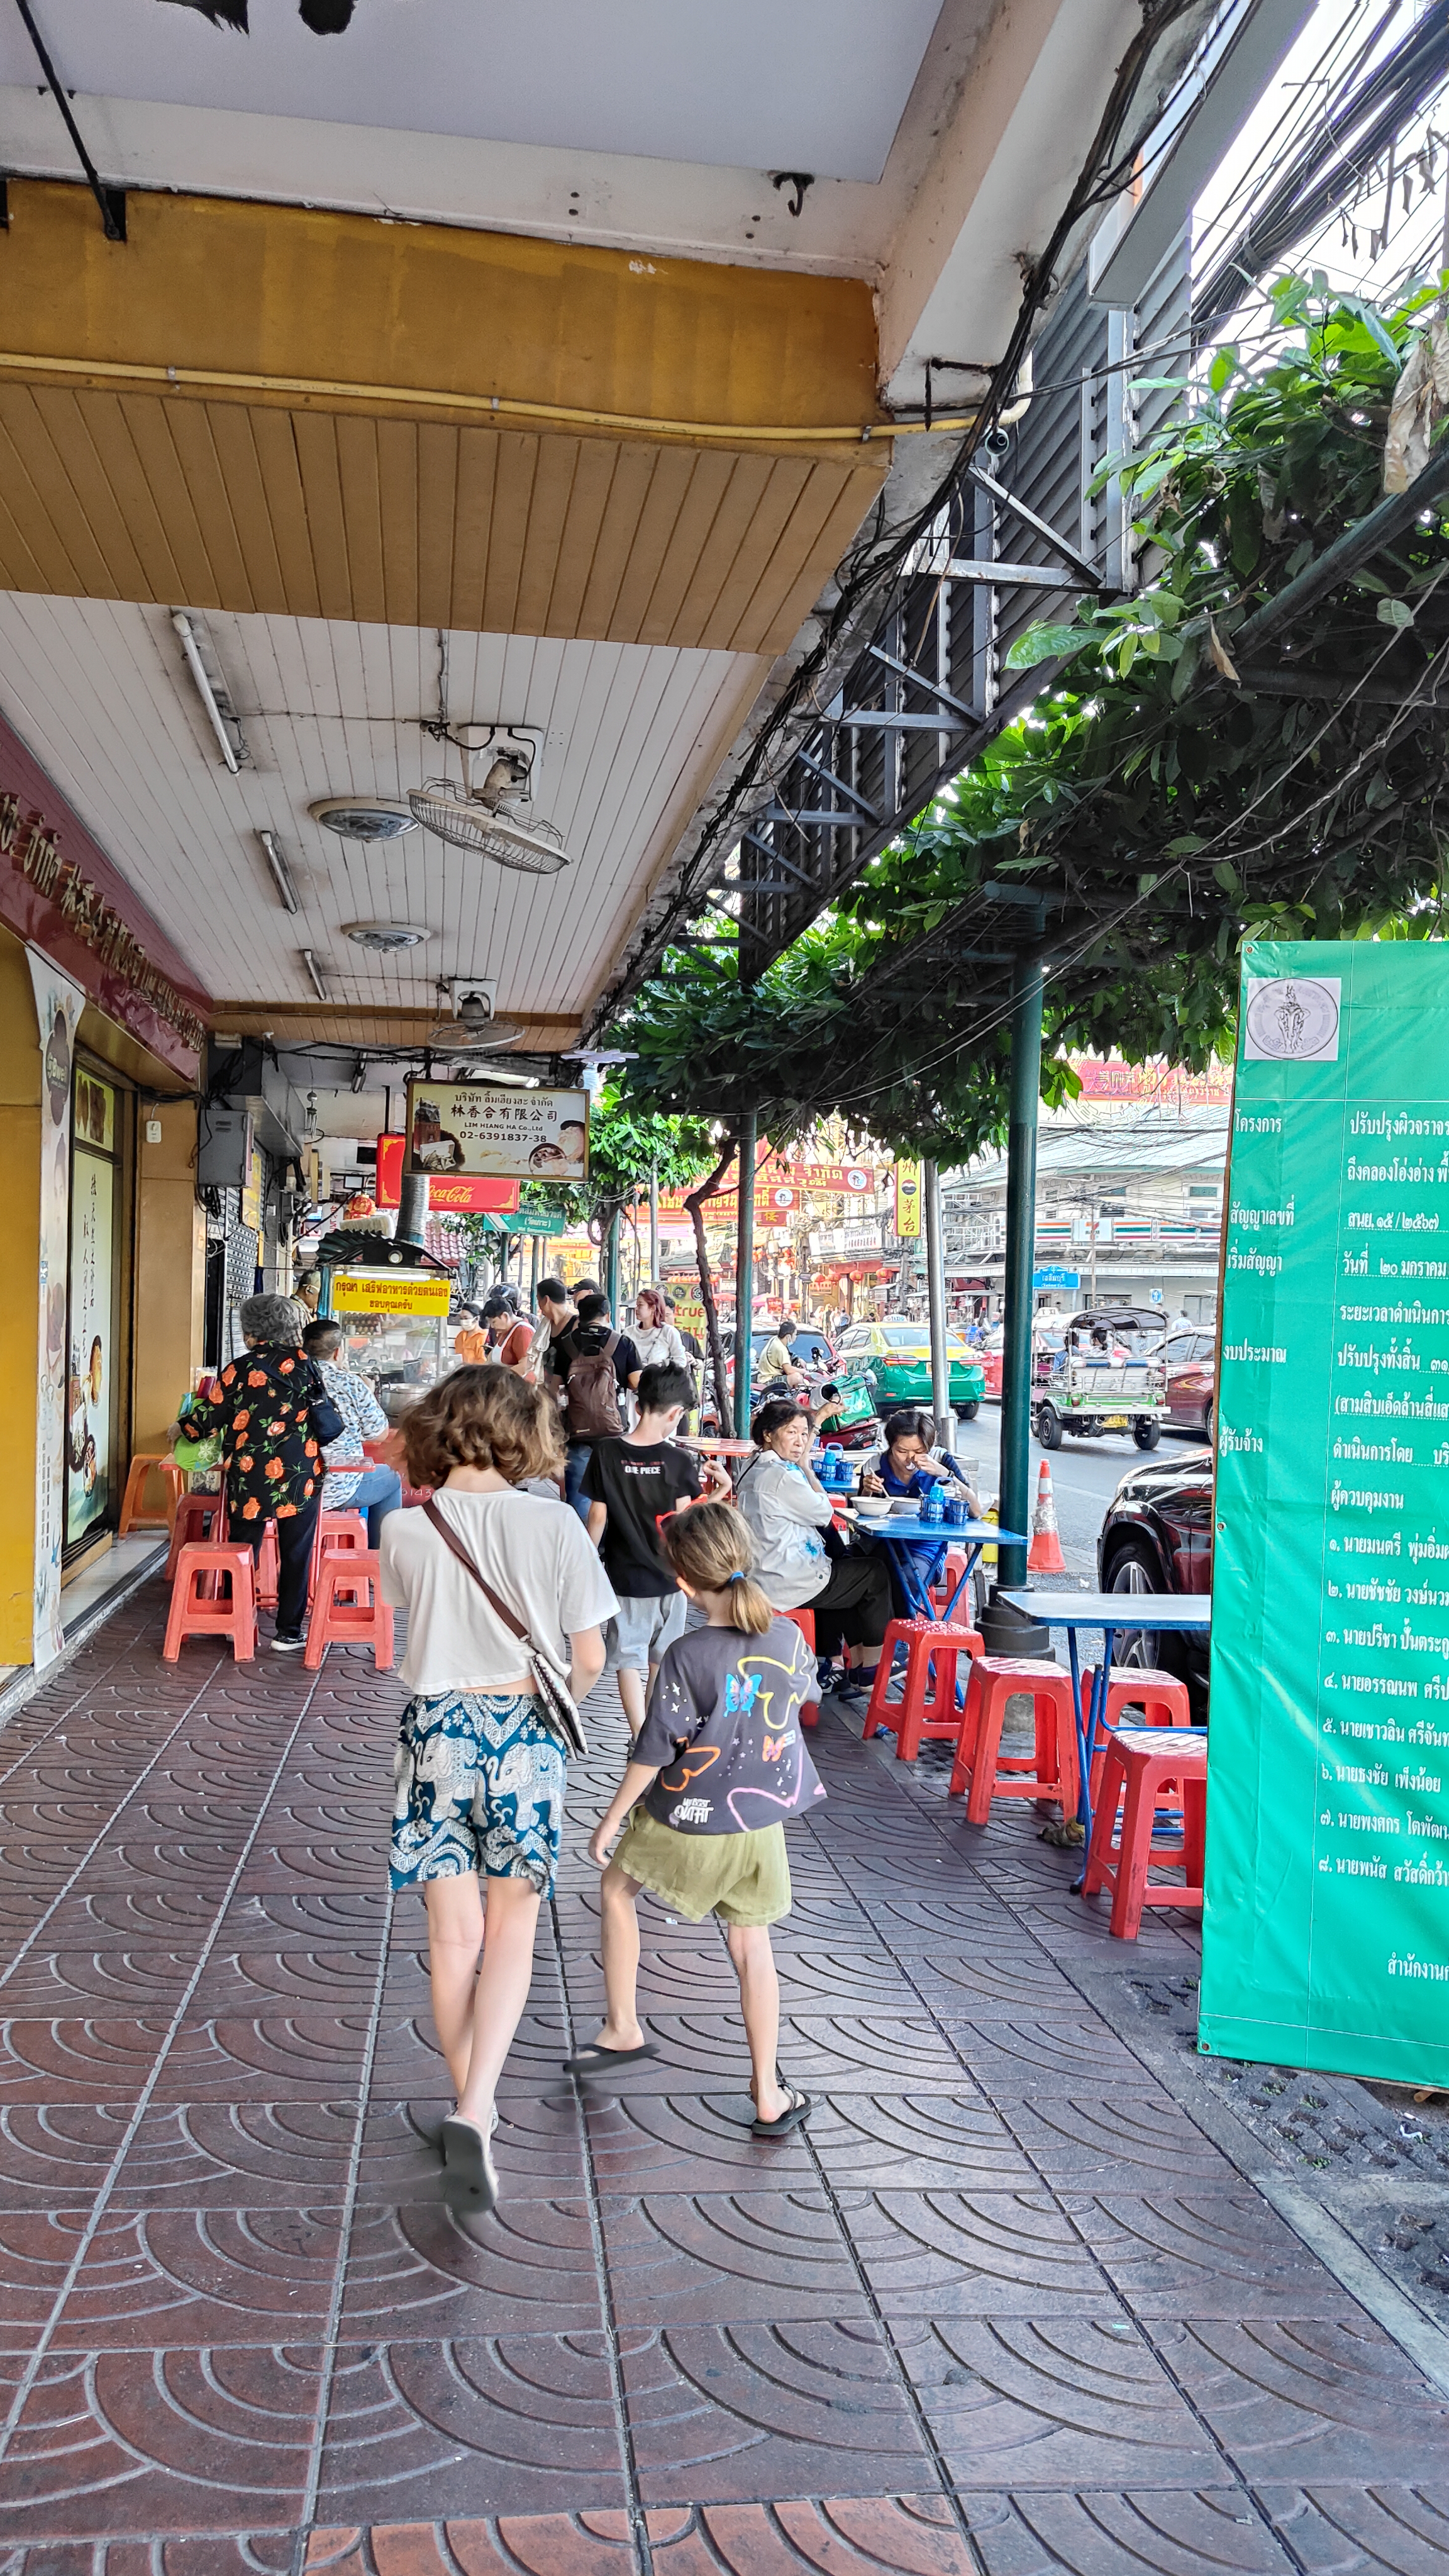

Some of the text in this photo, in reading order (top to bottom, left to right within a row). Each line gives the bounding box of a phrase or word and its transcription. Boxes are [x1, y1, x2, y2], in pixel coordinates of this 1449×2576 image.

[450, 1104, 557, 1122] 林香合有限公司
[531, 1096, 553, 1107] จำกัด
[1234, 1108, 1282, 1134] โครงการ
[460, 1131, 547, 1143] 02-6391837-38
[1348, 1150, 1449, 1183] ถึงคลองโอ่งอ่าง พื้
[1230, 1194, 1295, 1231] สัญญาเลขที่
[1227, 1243, 1283, 1277] เริ่มสัญญา
[1342, 1243, 1368, 1274] วันที่
[1401, 1260, 1447, 1276] มกราคม
[1223, 1338, 1287, 1363] งบประมาณ
[1338, 1337, 1420, 1376] ปรับปรุงทั้งสิ้น
[1219, 1426, 1263, 1458] ผู้รับจ้าง
[1333, 1436, 1413, 1464] ดำเนินการโดย
[1331, 1480, 1404, 1514] ผู้ควบคุมงาน
[1343, 1531, 1401, 1557] นายมนตรี
[1346, 1577, 1401, 1603] นายชัชชัย
[1343, 1622, 1396, 1648] นายปรีชา
[1336, 1762, 1389, 1786] นายธงชัย
[1395, 1765, 1441, 1793] เพ็งน้อย
[1338, 1811, 1400, 1835] นายพงศกร
[1336, 1855, 1387, 1880] นายพนัส
